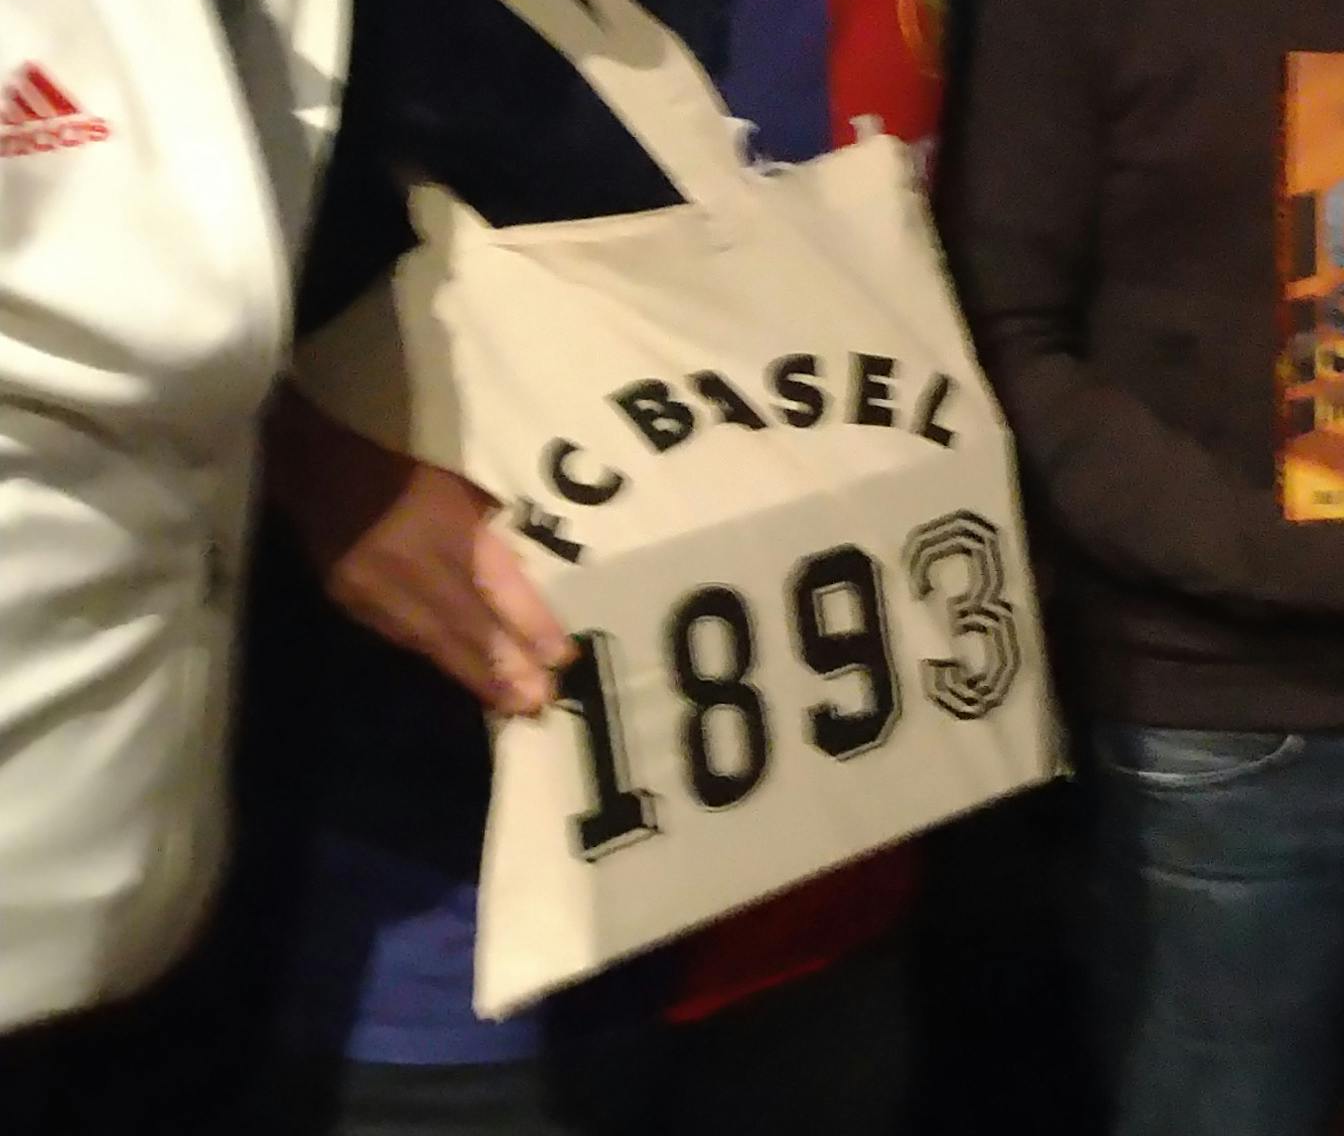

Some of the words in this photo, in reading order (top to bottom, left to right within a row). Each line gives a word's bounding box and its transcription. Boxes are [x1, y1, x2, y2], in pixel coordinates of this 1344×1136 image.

[510, 435, 629, 565] FC
[605, 350, 961, 453] BASEL
[554, 509, 1021, 863] 1893
